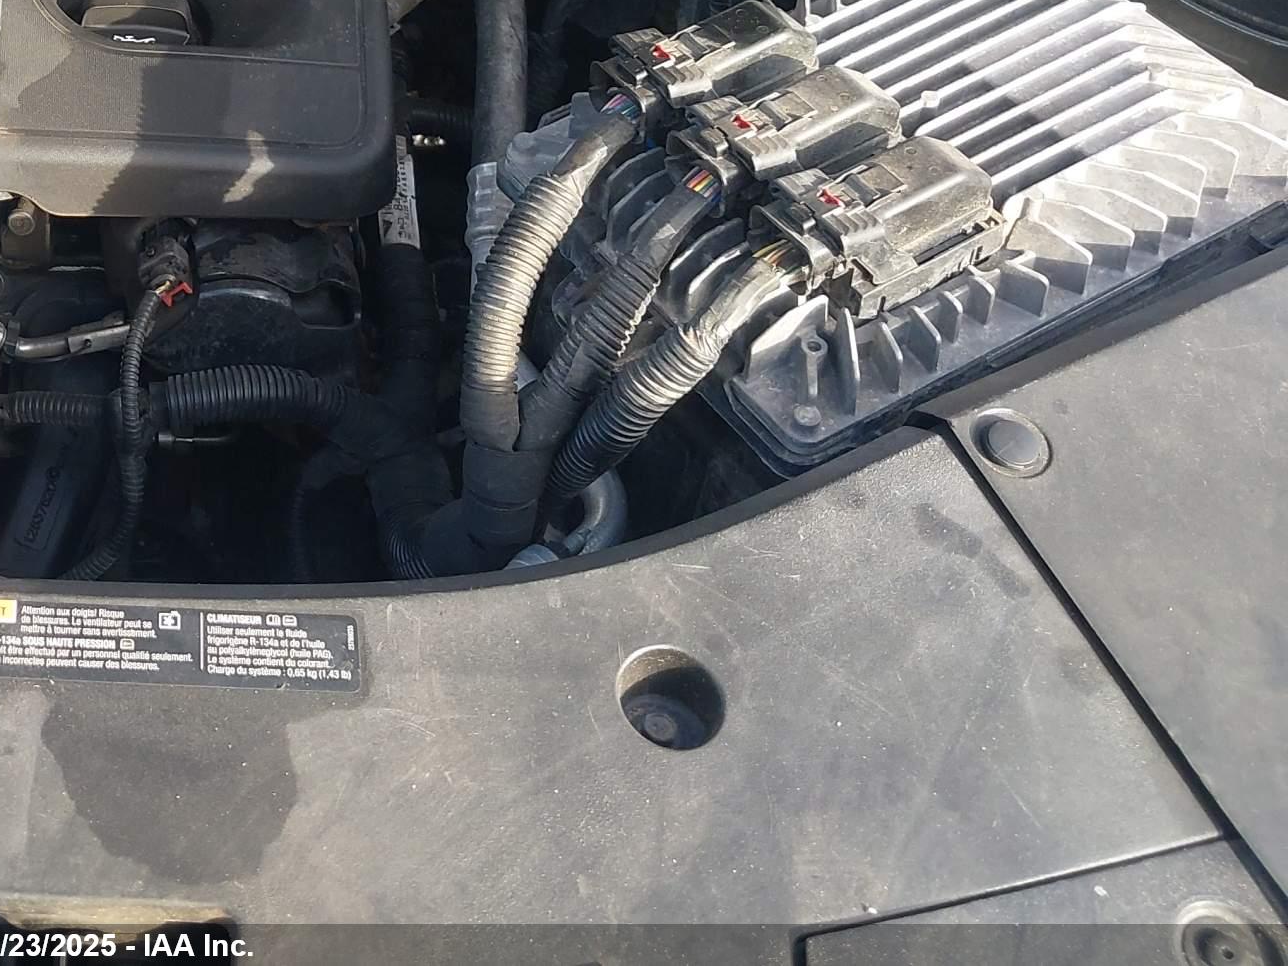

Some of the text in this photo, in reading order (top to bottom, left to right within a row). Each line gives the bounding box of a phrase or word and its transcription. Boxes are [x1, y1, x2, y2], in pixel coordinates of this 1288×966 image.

[21, 605, 125, 619] Attention aux doigts! Risque
[206, 613, 262, 625] CLIMATISEUR
[20, 615, 153, 629] de blessures. Le ventilateur peut se
[20, 624, 157, 638] mettre à tourner sans avertissement.
[206, 626, 307, 638] Utiliser seulement le fluide
[22, 636, 45, 647] SOUS
[46, 637, 73, 648] HAUTE
[74, 638, 116, 650] PRESSION
[207, 635, 325, 649] frigorigène R-134a et de l'huile
[7, 645, 24, 655] être
[25, 646, 55, 656] effectué
[56, 648, 70, 658] par
[71, 649, 82, 657] un
[82, 649, 121, 659] personnel
[121, 650, 150, 661] qualifié
[151, 651, 194, 662] seulement.
[289, 647, 311, 658] (huile
[2, 655, 44, 666] incorrectes
[45, 658, 77, 668] peuvent
[77, 659, 104, 668] causer
[105, 659, 120, 669] des
[120, 660, 160, 670] blessures.
[207, 655, 218, 663] Le
[218, 656, 251, 666] système
[252, 657, 284, 667] contient
[285, 658, 296, 667] du
[206, 665, 236, 676] Charge
[236, 666, 247, 675] du
[248, 667, 281, 677] système
[306, 669, 318, 680] kg
[340, 670, 352, 681] lb)
